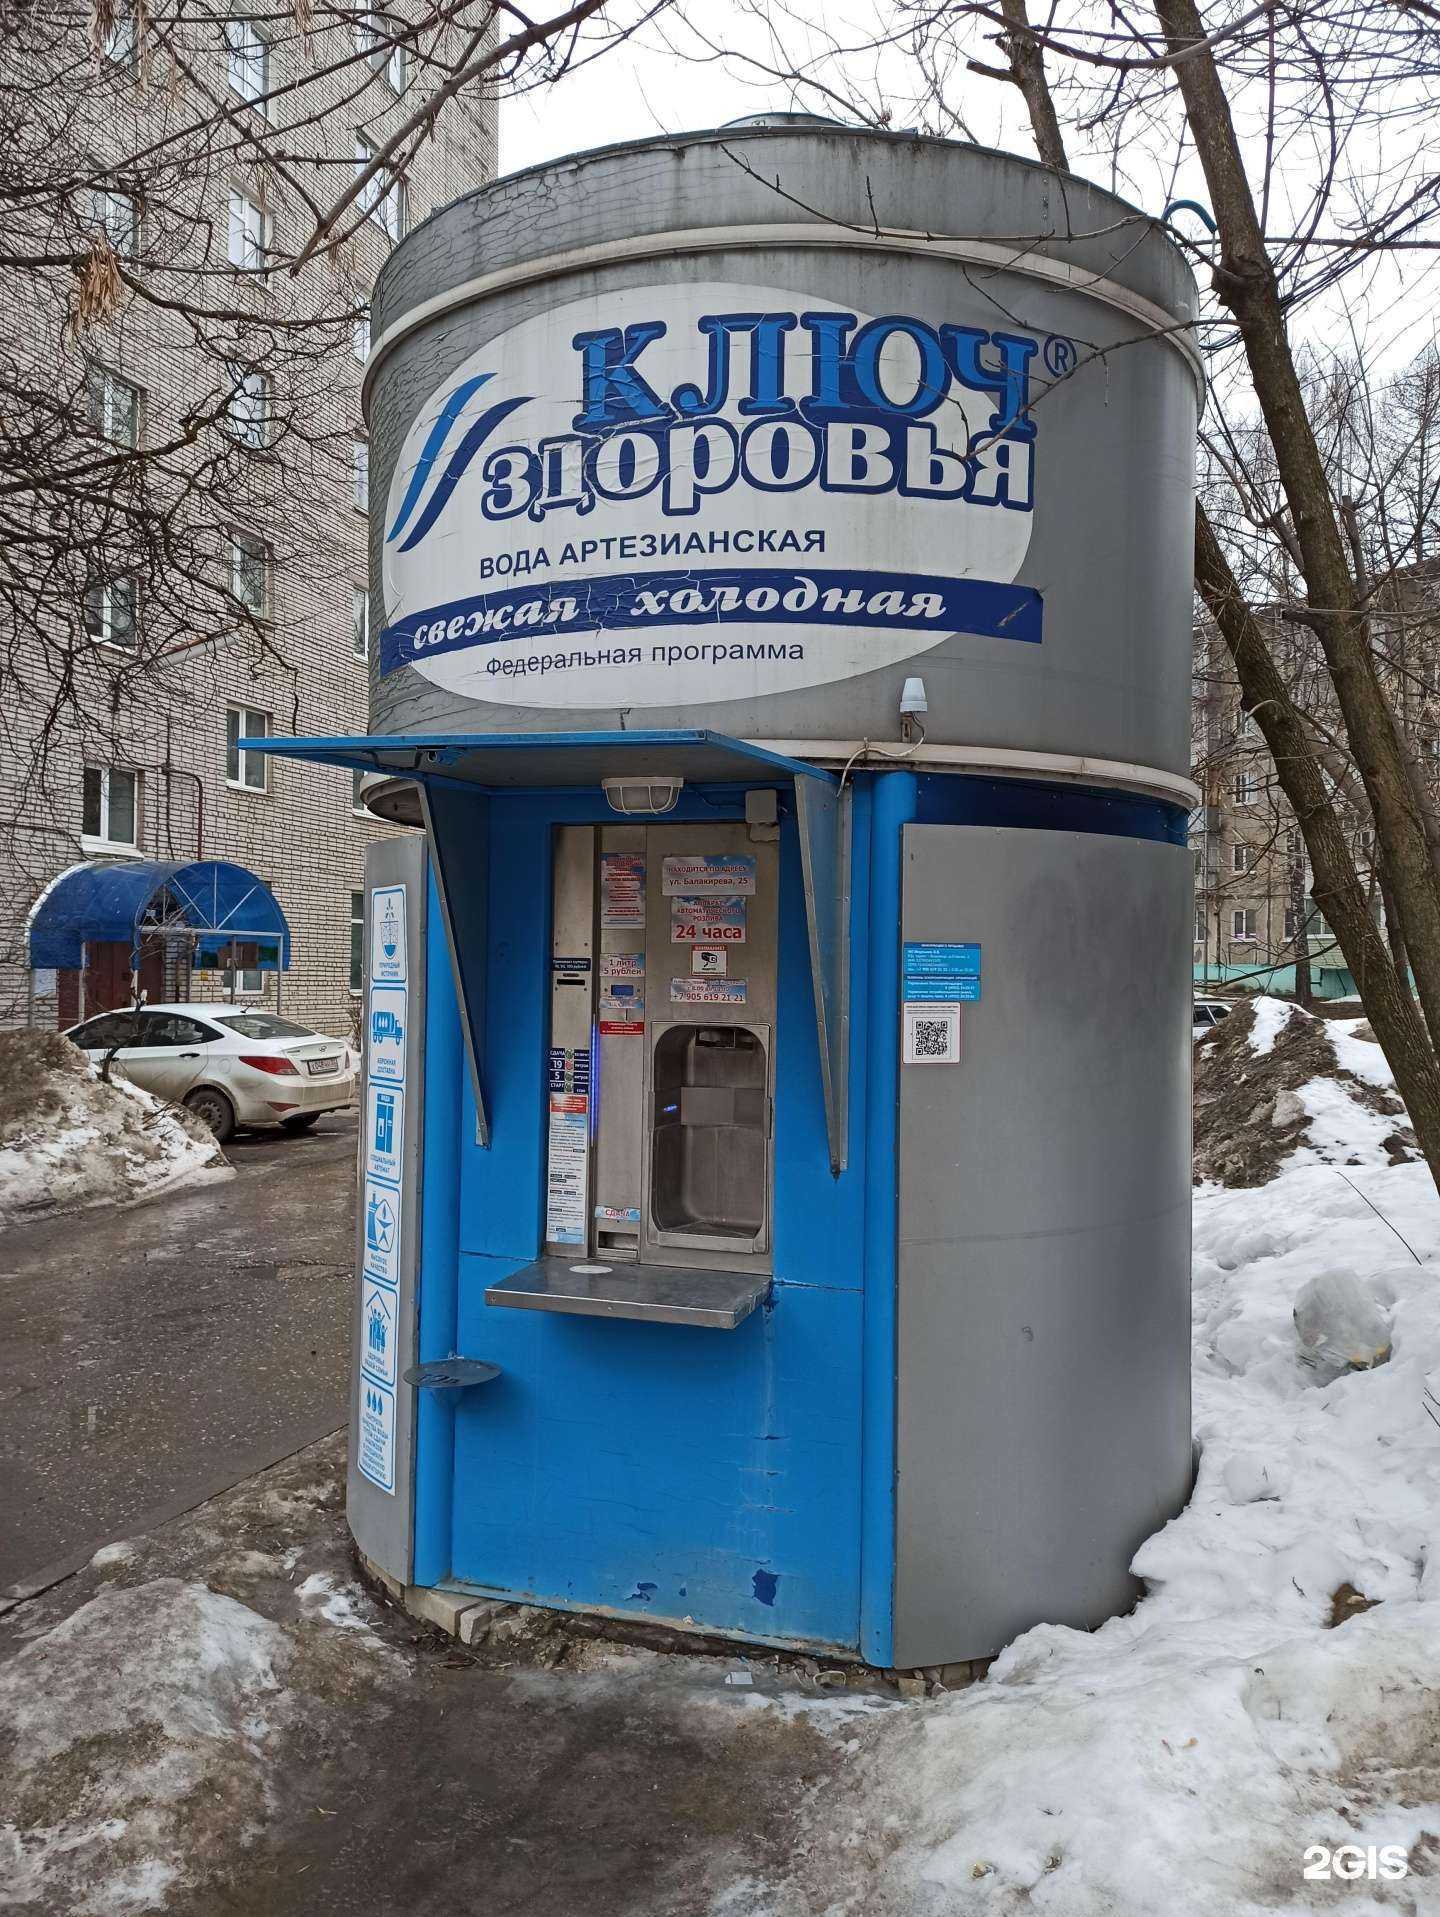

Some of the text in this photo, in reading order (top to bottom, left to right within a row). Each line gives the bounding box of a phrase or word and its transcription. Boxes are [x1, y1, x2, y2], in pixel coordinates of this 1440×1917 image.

[572, 311, 1038, 439] КЛЮЧ
[481, 415, 1035, 521] здоровья
[479, 529, 827, 580] ВОДА АРТЕЗИАНСКАЯ
[413, 577, 947, 650] свежая холодная
[486, 644, 805, 677] Федеральная программа
[737, 876, 748, 885] 25
[675, 924, 743, 939] 24 часа
[616, 960, 637, 968] литр
[602, 967, 609, 976] 5
[686, 992, 702, 1001] 905
[703, 993, 720, 1001] 619
[721, 993, 731, 1002] 21
[553, 1060, 563, 1069] 19
[554, 1071, 561, 1080] 5
